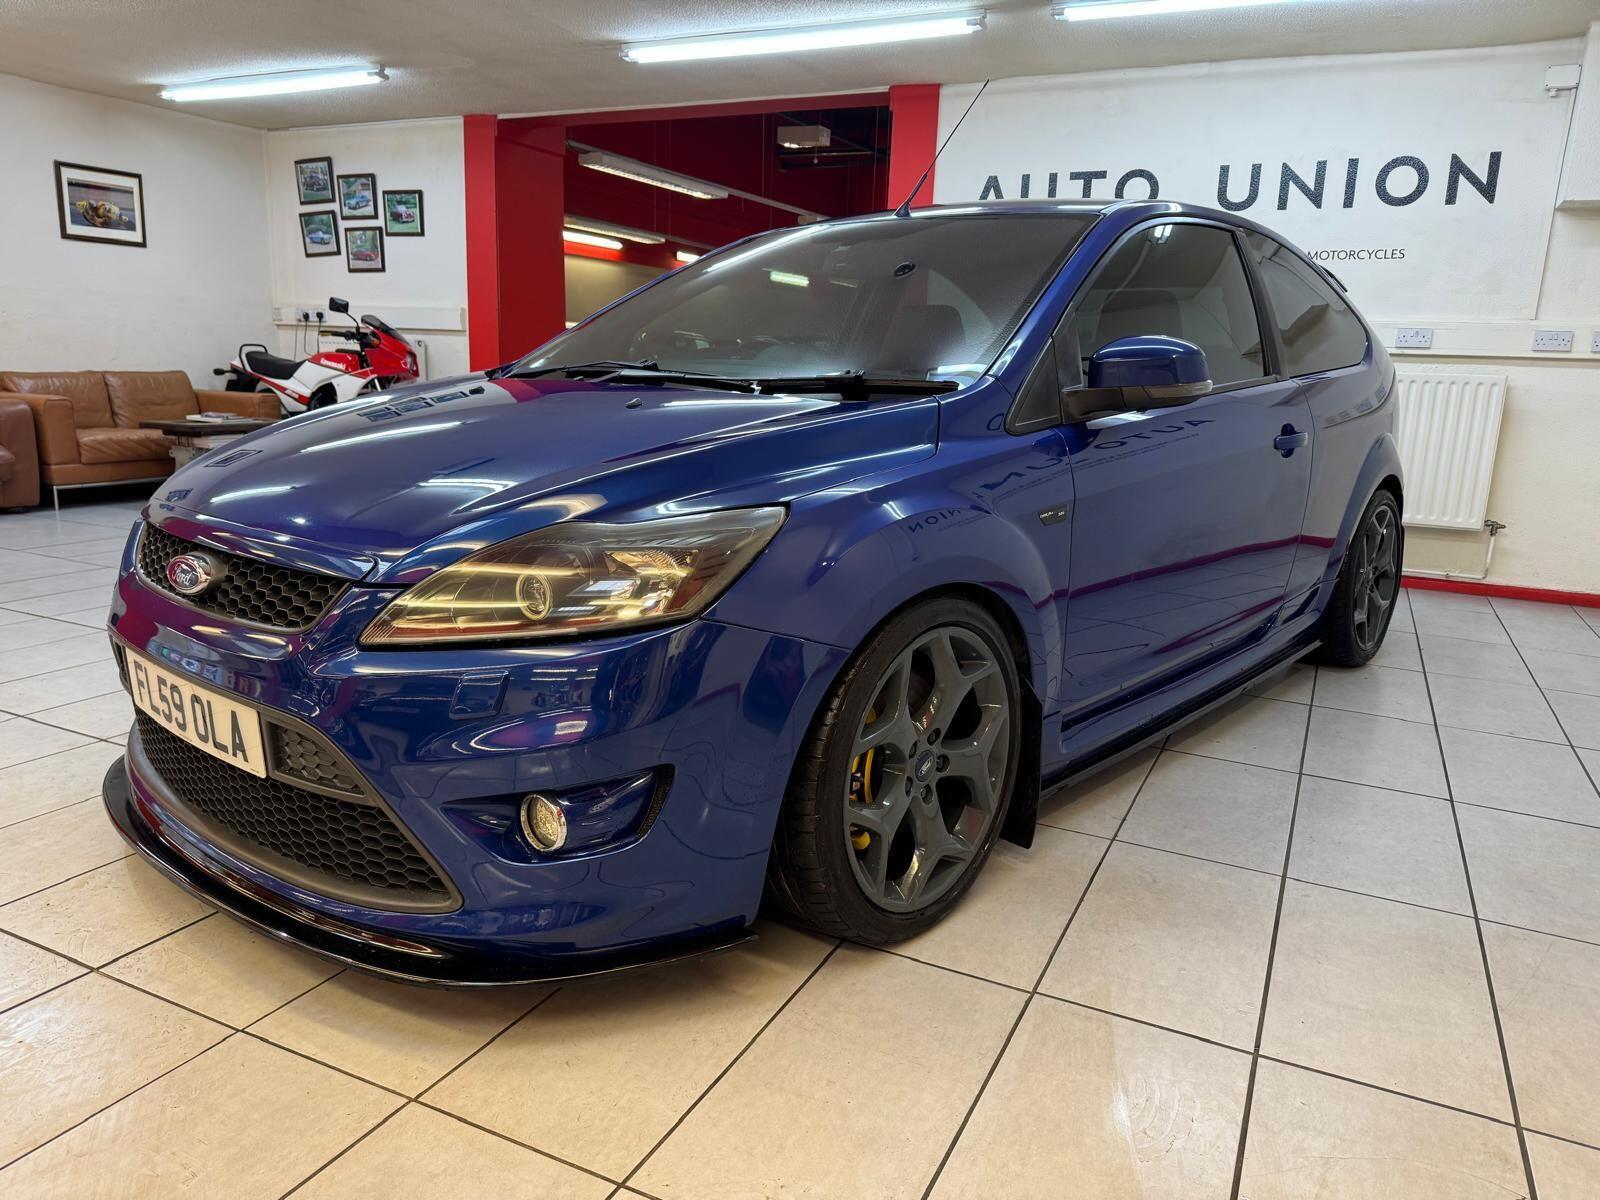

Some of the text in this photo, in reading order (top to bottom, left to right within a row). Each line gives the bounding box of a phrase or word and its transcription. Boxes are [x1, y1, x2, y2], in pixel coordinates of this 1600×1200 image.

[979, 151, 1502, 211] AUTO UNION
[1307, 249, 1405, 261] MOTORCYCLES
[171, 562, 193, 586] Ford
[133, 658, 250, 764] FL59 OLA
